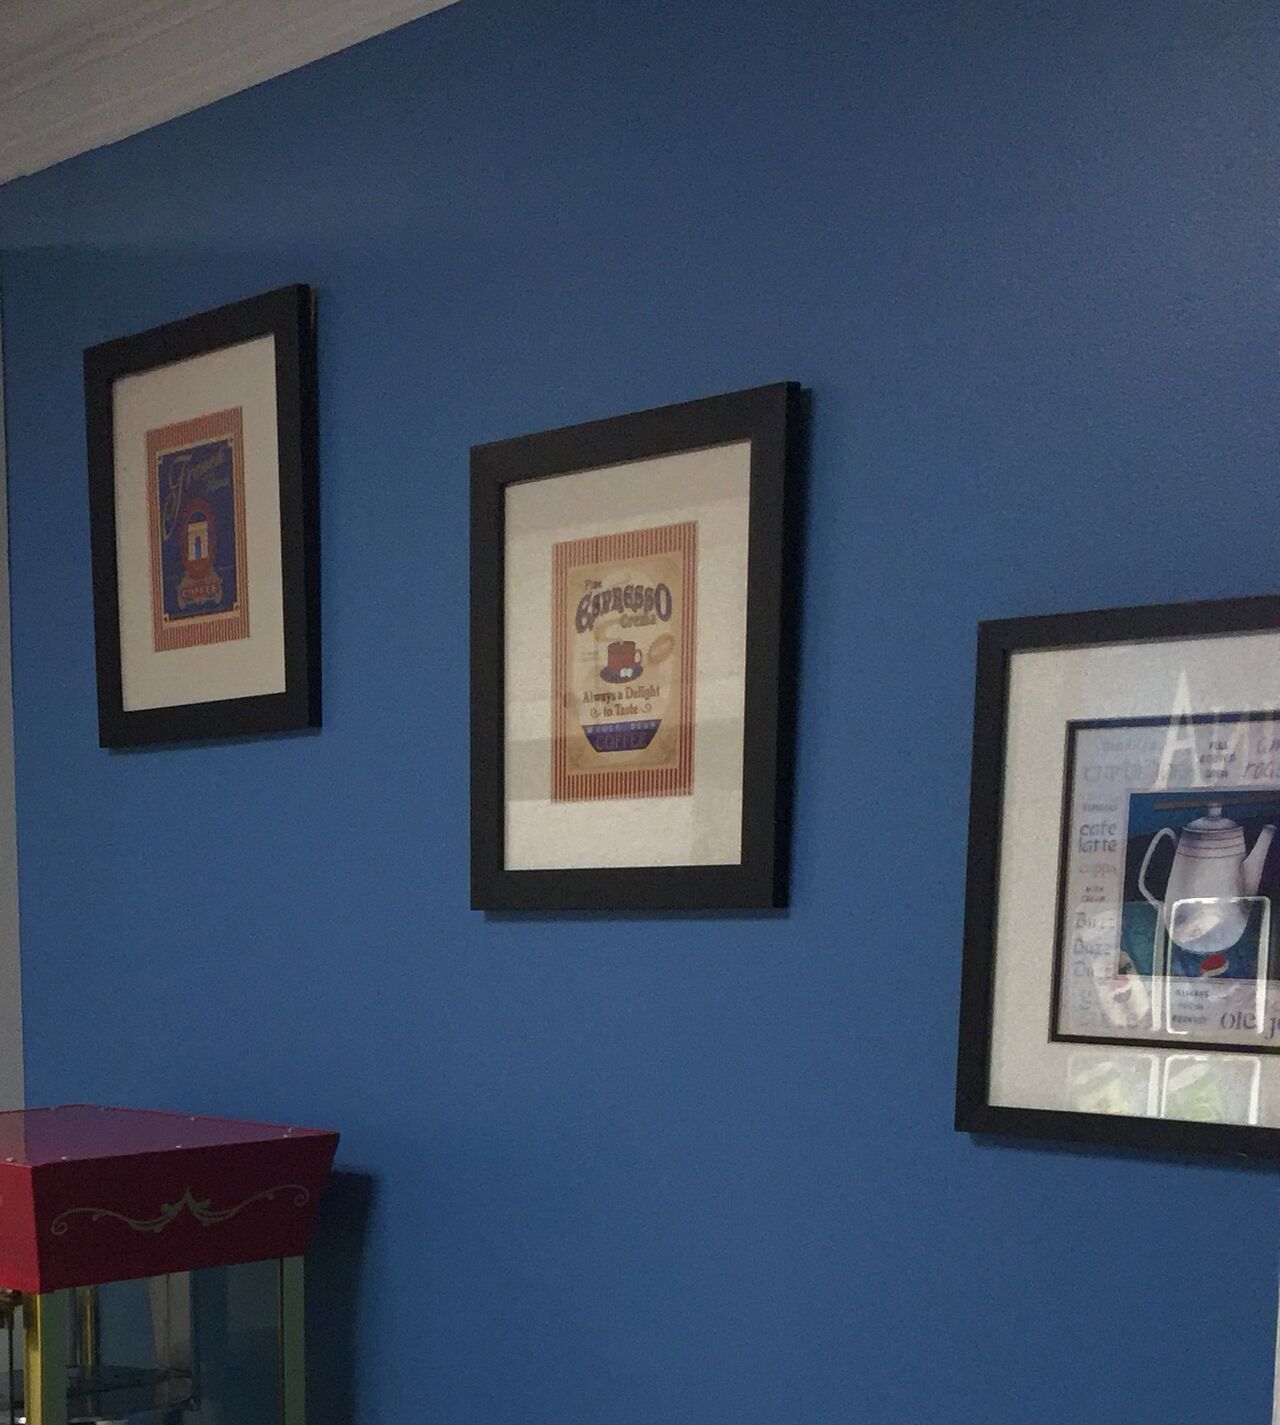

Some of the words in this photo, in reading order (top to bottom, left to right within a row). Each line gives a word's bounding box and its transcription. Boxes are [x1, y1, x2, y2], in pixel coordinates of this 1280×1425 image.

[575, 582, 672, 634] ESPRESSO
[583, 691, 616, 705] Always
[625, 684, 661, 701] Delight
[603, 705, 613, 717] to
[615, 703, 639, 716] Taste
[1079, 820, 1118, 837] cafe
[1078, 837, 1118, 854] latte
